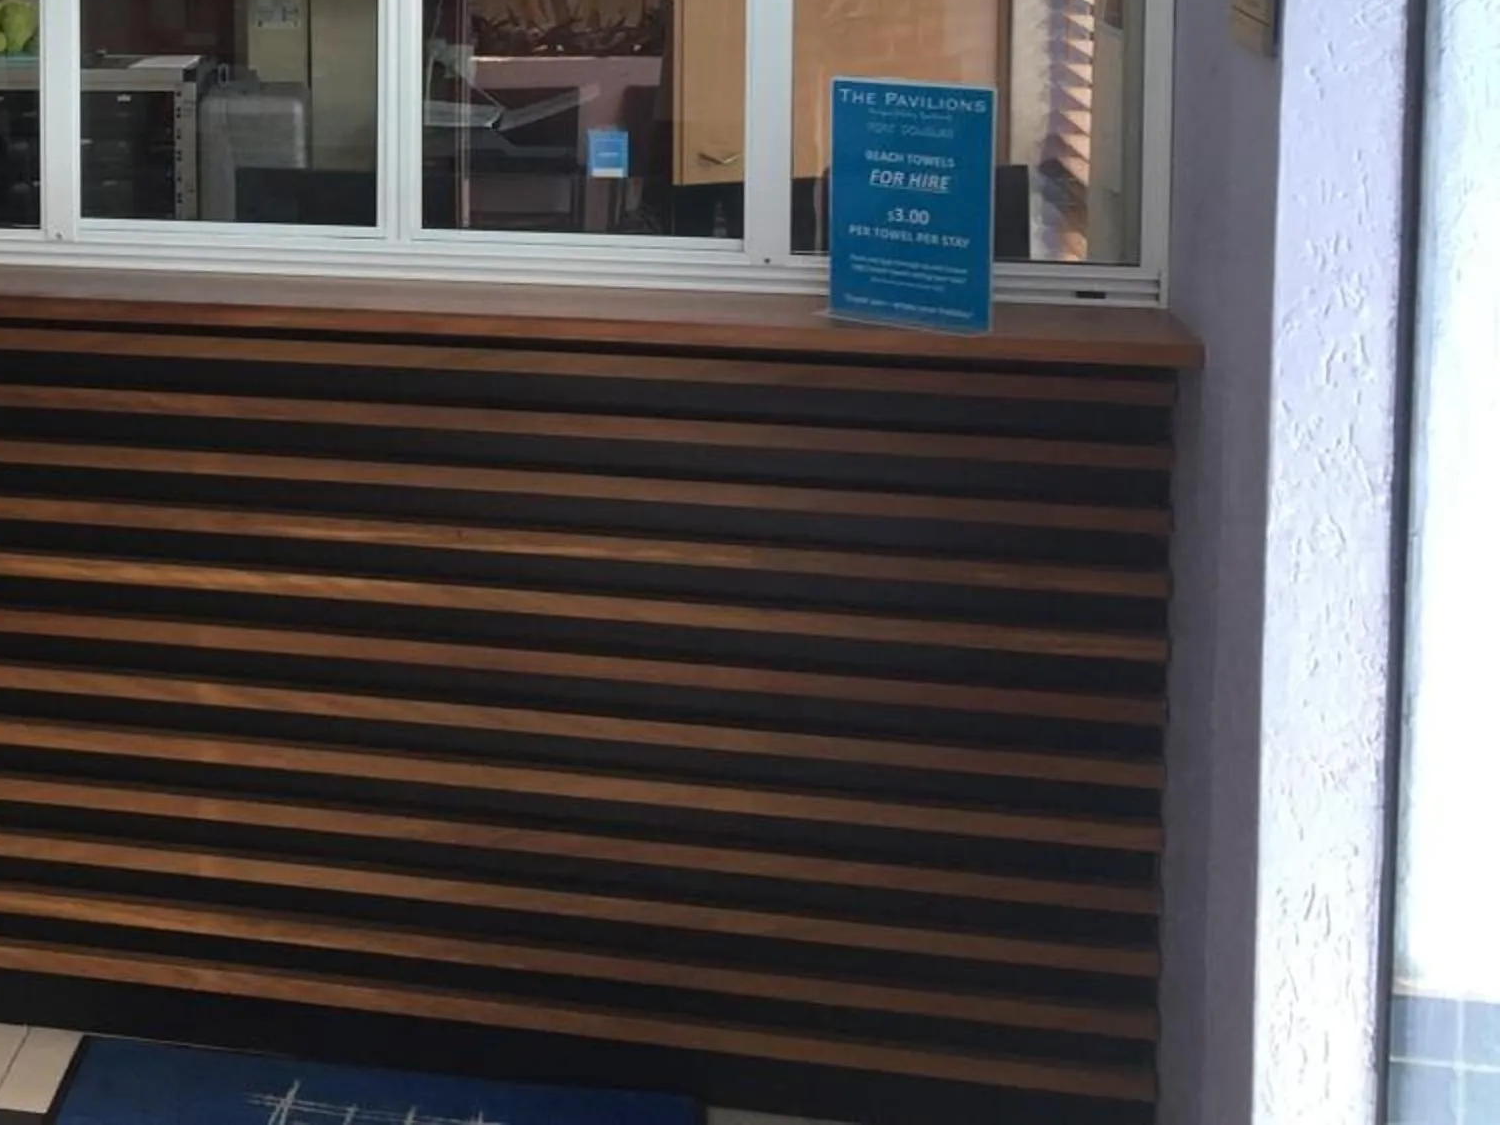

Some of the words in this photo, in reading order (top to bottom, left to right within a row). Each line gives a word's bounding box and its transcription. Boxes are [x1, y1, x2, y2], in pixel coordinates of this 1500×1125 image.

[838, 88, 877, 105] THE
[885, 92, 987, 113] PAVILIONS
[864, 149, 904, 163] BEACH
[907, 153, 956, 168] TOWELS
[869, 168, 905, 187] FOR
[909, 173, 952, 192] HIRE
[887, 207, 930, 225] $3.00
[848, 224, 871, 236] PER
[874, 226, 913, 242] TOWEL
[915, 231, 939, 245] PER
[941, 235, 971, 248] STAY
